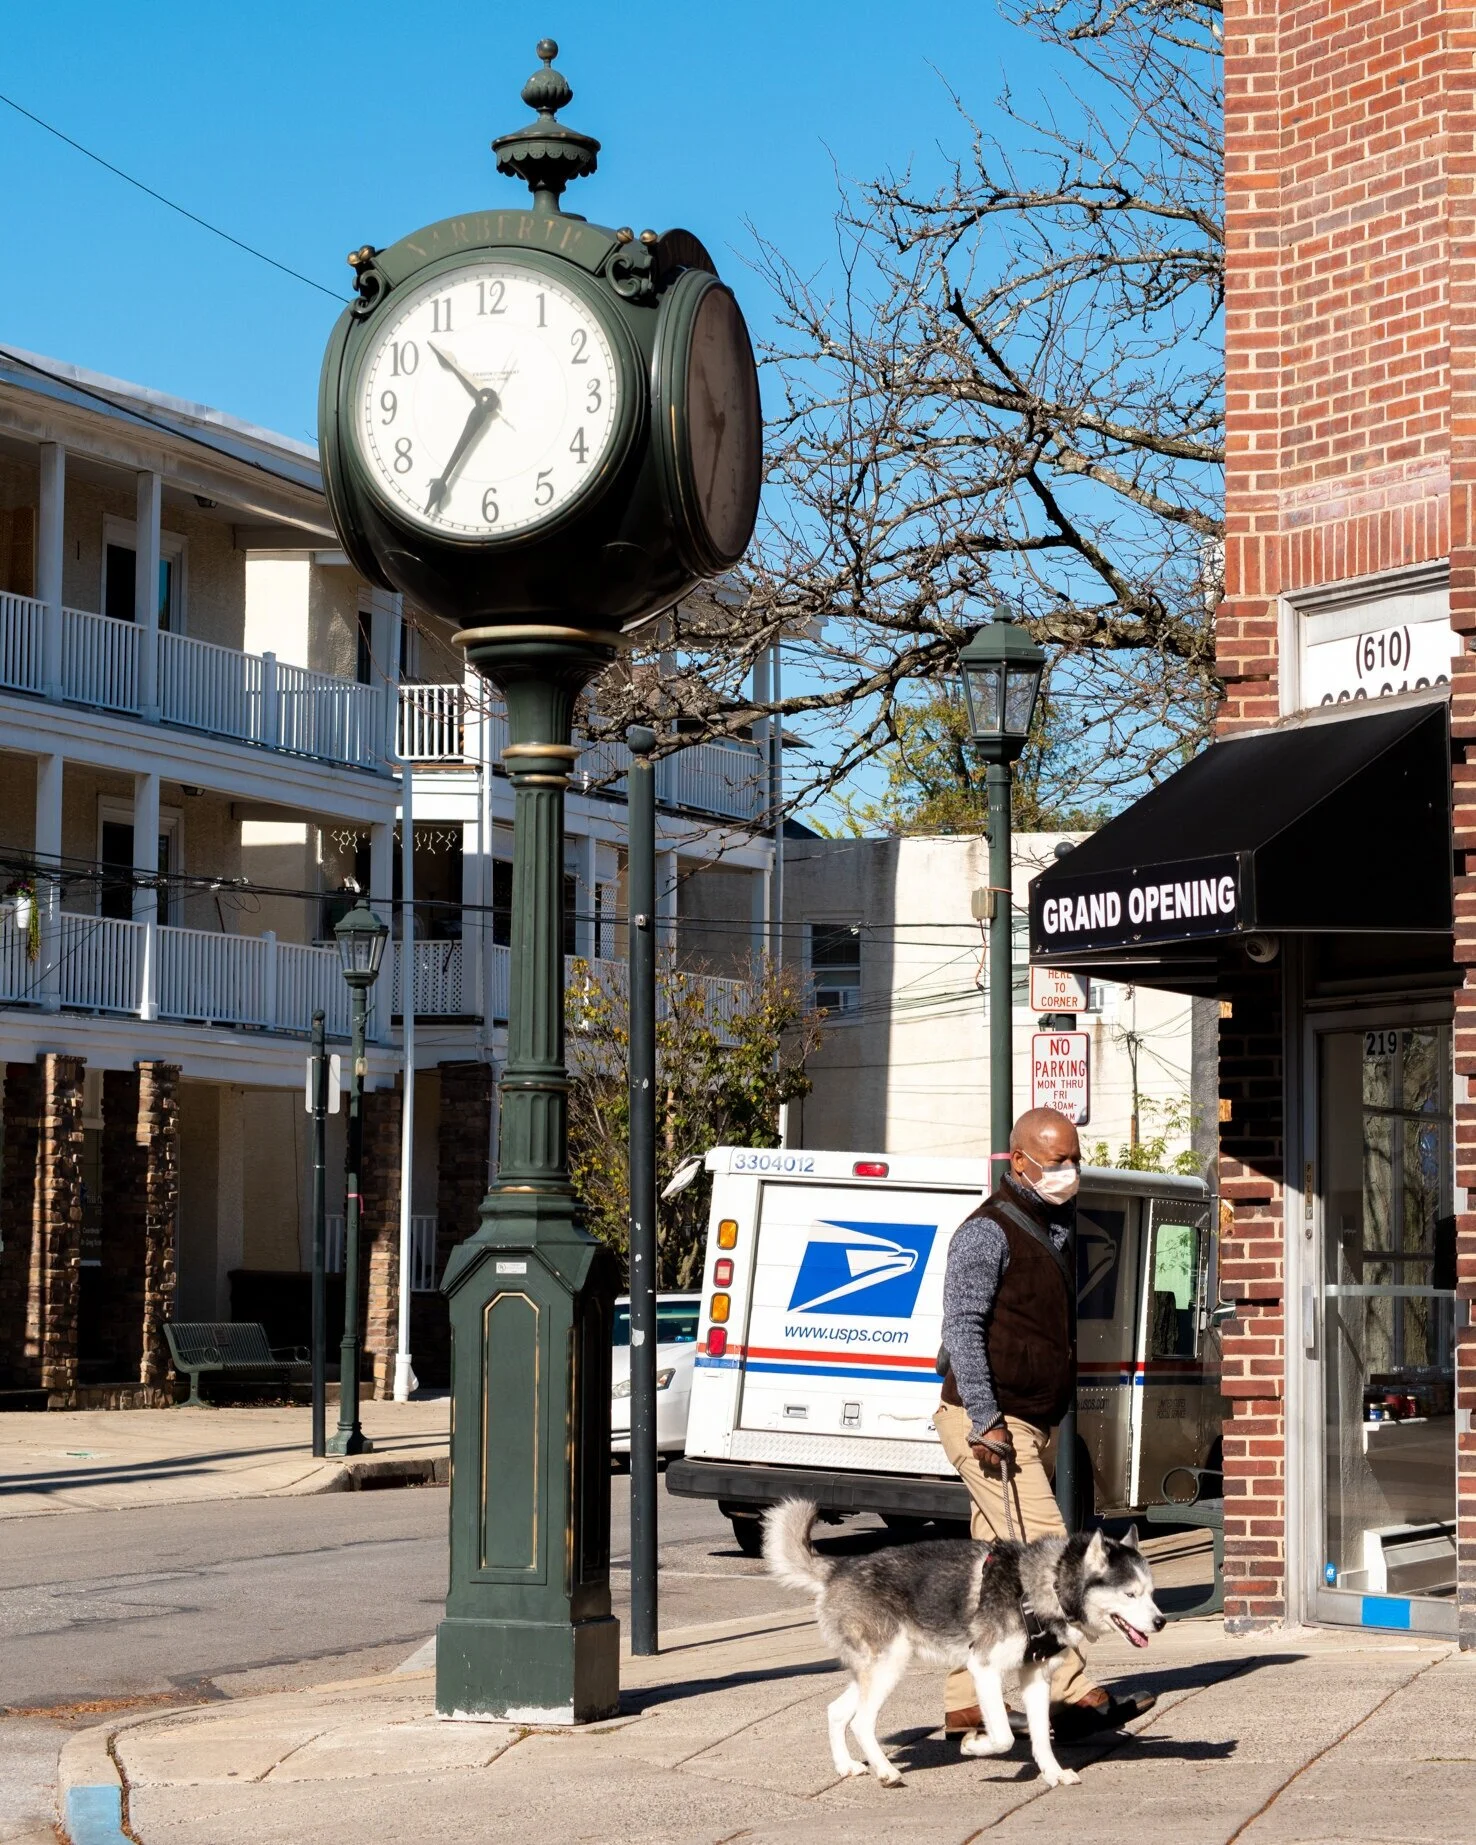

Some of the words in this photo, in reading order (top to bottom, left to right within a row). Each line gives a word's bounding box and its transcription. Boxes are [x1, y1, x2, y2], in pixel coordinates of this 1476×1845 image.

[430, 297, 454, 333] 11
[476, 280, 507, 315] 12
[536, 293, 548, 328] 1
[390, 341, 419, 377] 10
[571, 329, 590, 364] 2
[381, 390, 397, 425] 9
[586, 379, 602, 414] 3
[394, 438, 412, 473] 8
[569, 427, 589, 463] 4
[534, 466, 554, 506] 5
[481, 488, 499, 523] 6
[1355, 625, 1411, 679] (610)
[1043, 892, 1121, 934] GRAND
[1128, 876, 1235, 924] OPENING
[1041, 996, 1078, 1007] CORNER
[1055, 982, 1066, 993] TO
[1050, 1038, 1070, 1056] NO
[1366, 1031, 1397, 1056] 219
[1035, 1060, 1085, 1077] PARKING
[1037, 1080, 1056, 1089] MON
[1061, 1079, 1084, 1088] THRU
[1053, 1090, 1068, 1100] FRI
[735, 1153, 815, 1173] 3304012
[784, 1325, 909, 1345] www.usps.com
